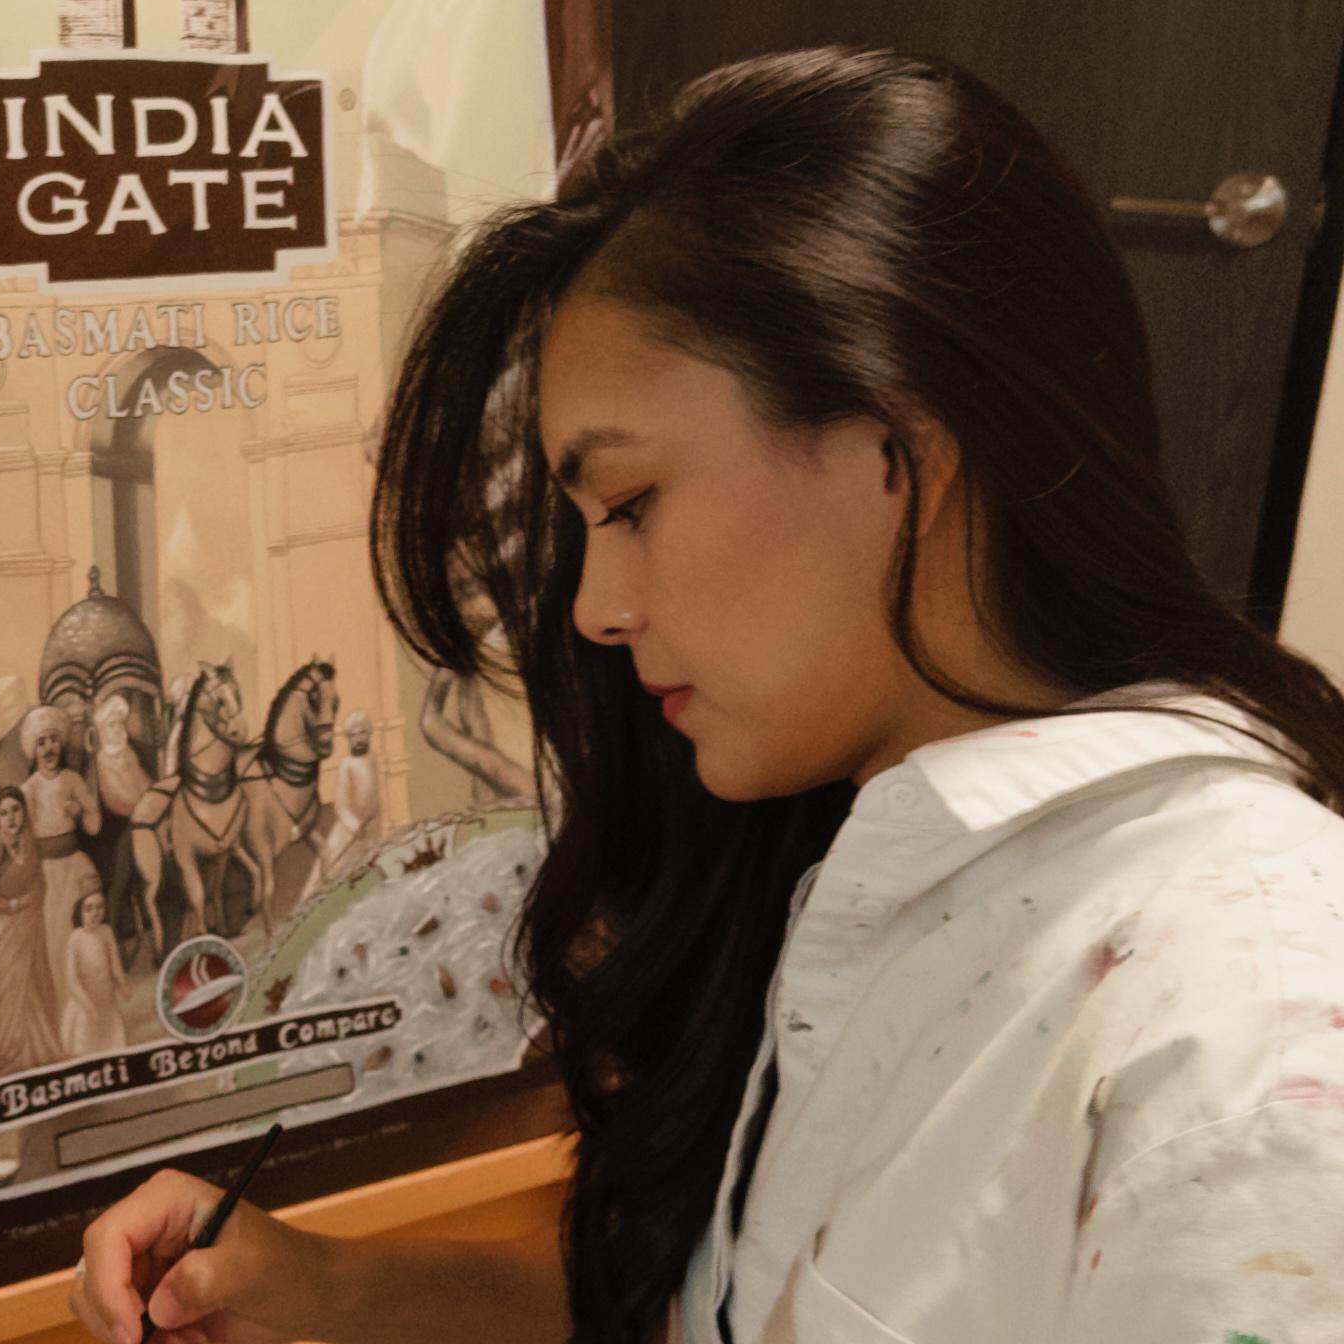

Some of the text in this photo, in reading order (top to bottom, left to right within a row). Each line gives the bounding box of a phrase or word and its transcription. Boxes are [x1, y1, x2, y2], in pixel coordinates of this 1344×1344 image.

[3, 91, 309, 160] INDIA
[16, 166, 299, 237] GATE
[233, 295, 343, 345] RICE
[66, 363, 269, 420] CLASSIC
[147, 1030, 258, 1080] Beyond
